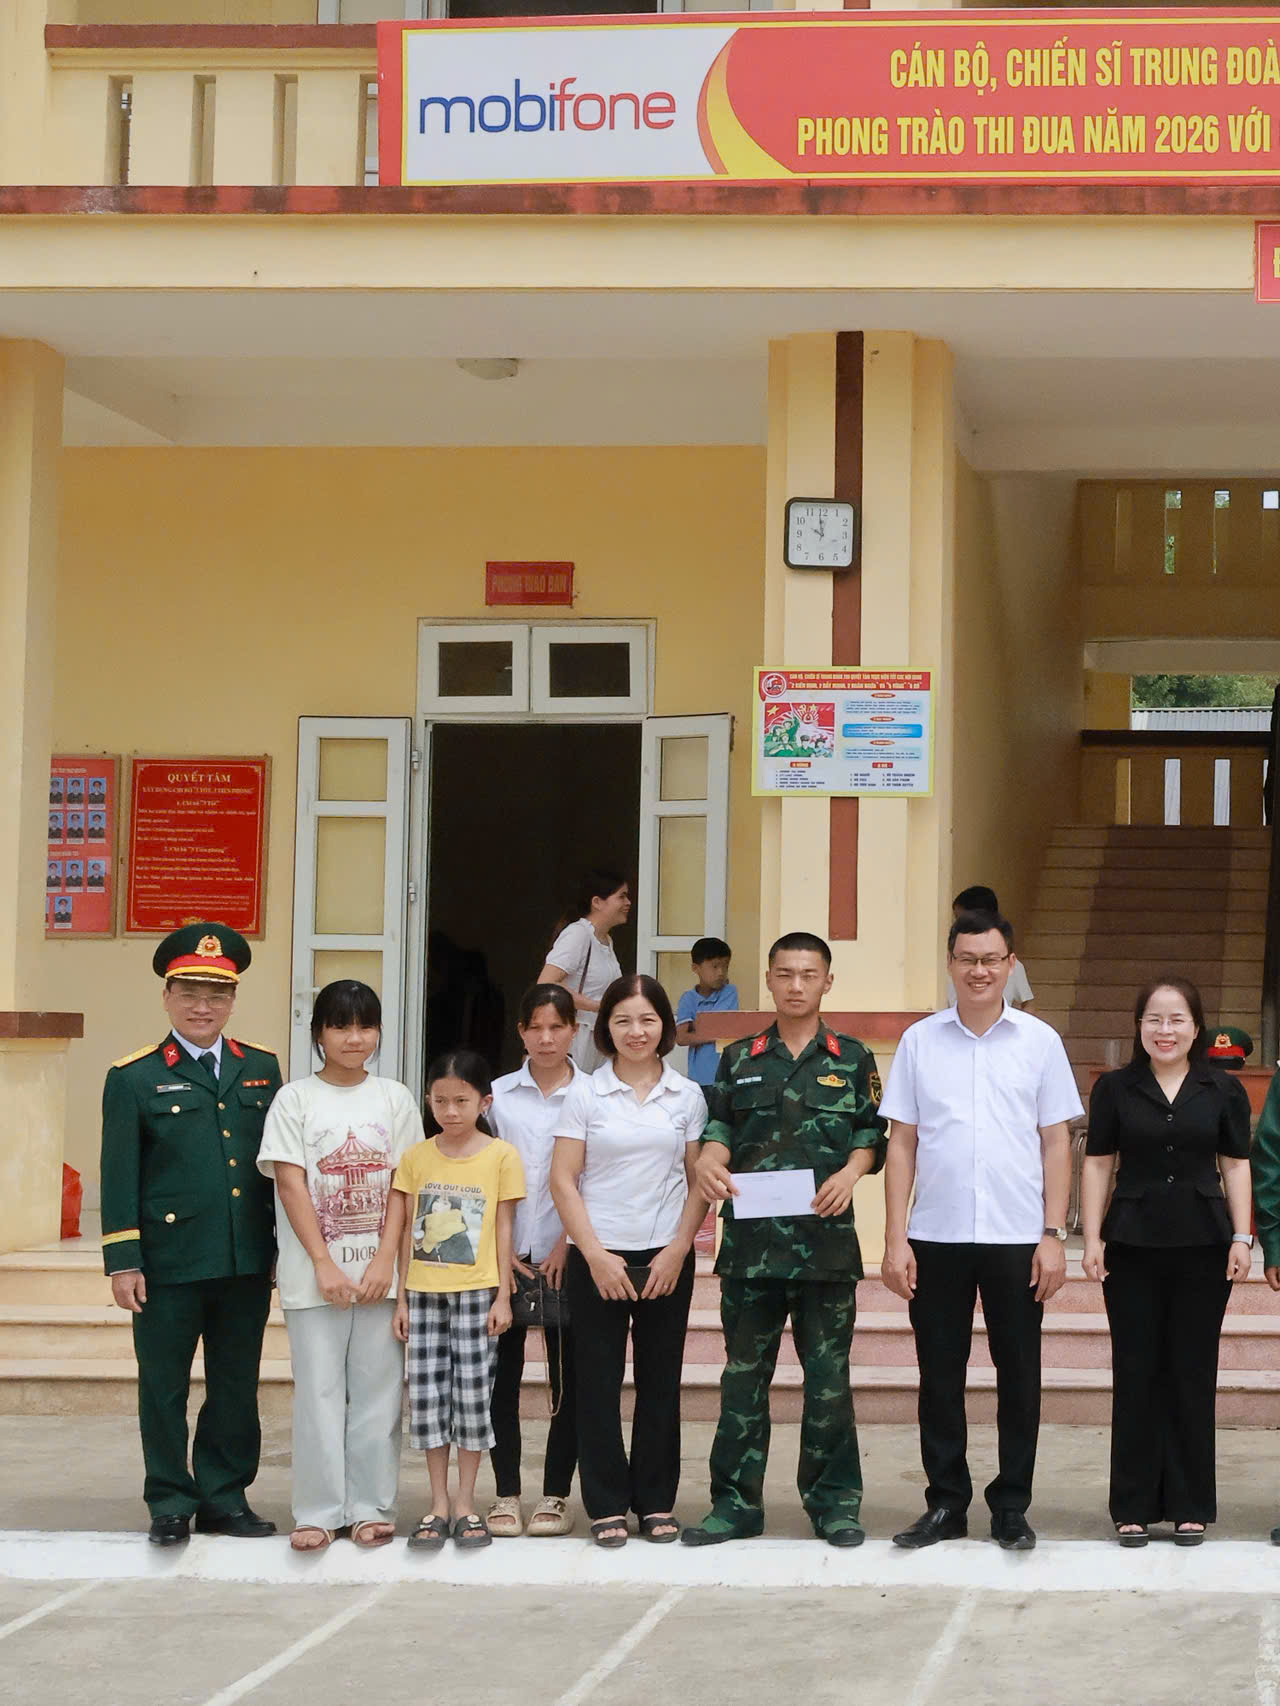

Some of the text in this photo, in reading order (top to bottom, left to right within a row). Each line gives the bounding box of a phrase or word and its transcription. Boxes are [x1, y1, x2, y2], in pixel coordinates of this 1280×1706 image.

[890, 42, 944, 88] CÁN
[954, 41, 997, 95] BỘ,
[1006, 35, 1086, 87] CHIẾN
[1095, 40, 1123, 87] SĨ
[1130, 47, 1219, 87] TRUNG
[418, 76, 676, 134] mobifone
[798, 115, 888, 156] PHONG
[897, 109, 964, 155] TRÀO
[973, 115, 1014, 154] THI
[1023, 115, 1075, 154] ĐUA
[1084, 107, 1146, 153] NĂM
[1155, 115, 1219, 153] 2026
[1228, 108, 1270, 153] VỚI
[806, 508, 814, 517] 11
[819, 508, 828, 517] 12
[835, 509, 839, 517] 1
[796, 517, 805, 525] 10
[842, 519, 848, 527] 2
[796, 530, 802, 538] 9
[842, 531, 848, 539] 3
[842, 545, 847, 553] 4
[804, 552, 809, 560] 7
[818, 553, 824, 561] 6
[833, 553, 838, 561] 5
[168, 770, 231, 783] QUYẾT TÂM
[342, 1246, 376, 1263] DIOR
